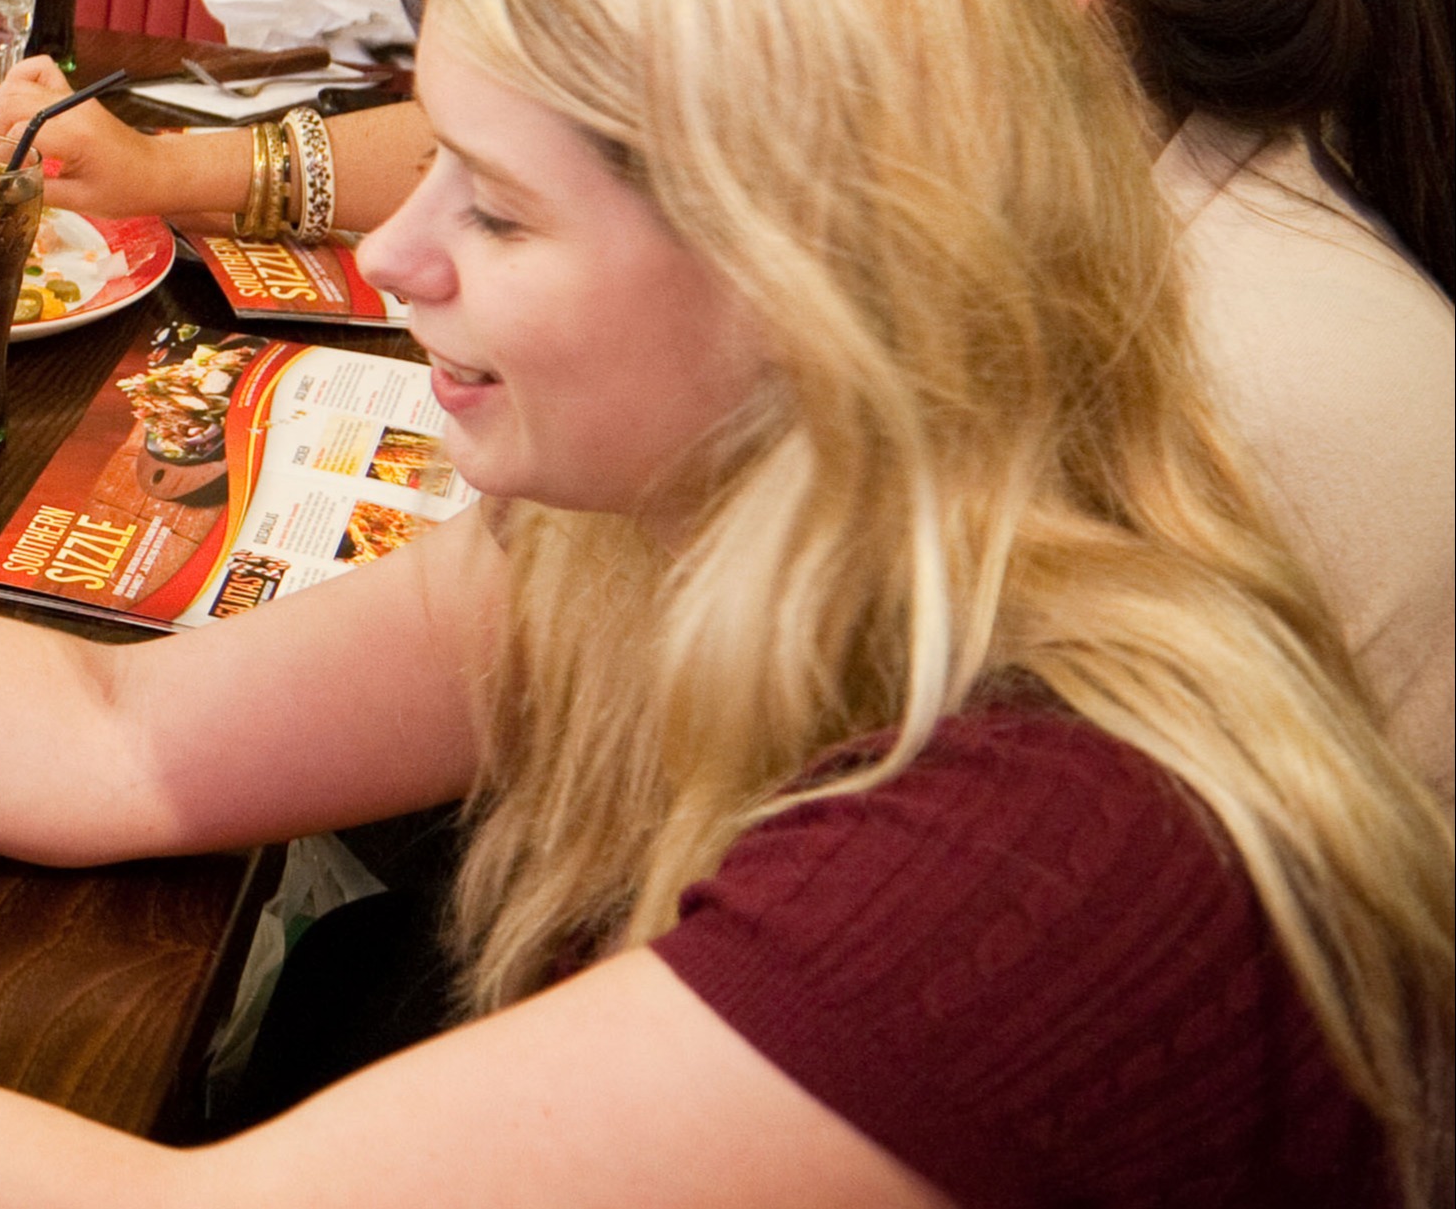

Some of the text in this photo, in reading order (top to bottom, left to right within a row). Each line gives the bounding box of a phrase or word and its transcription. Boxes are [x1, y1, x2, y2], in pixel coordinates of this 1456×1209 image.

[202, 237, 269, 299] SOUTHERN
[2, 505, 76, 575] SOUTHERN
[45, 514, 137, 590] SIZZLE
